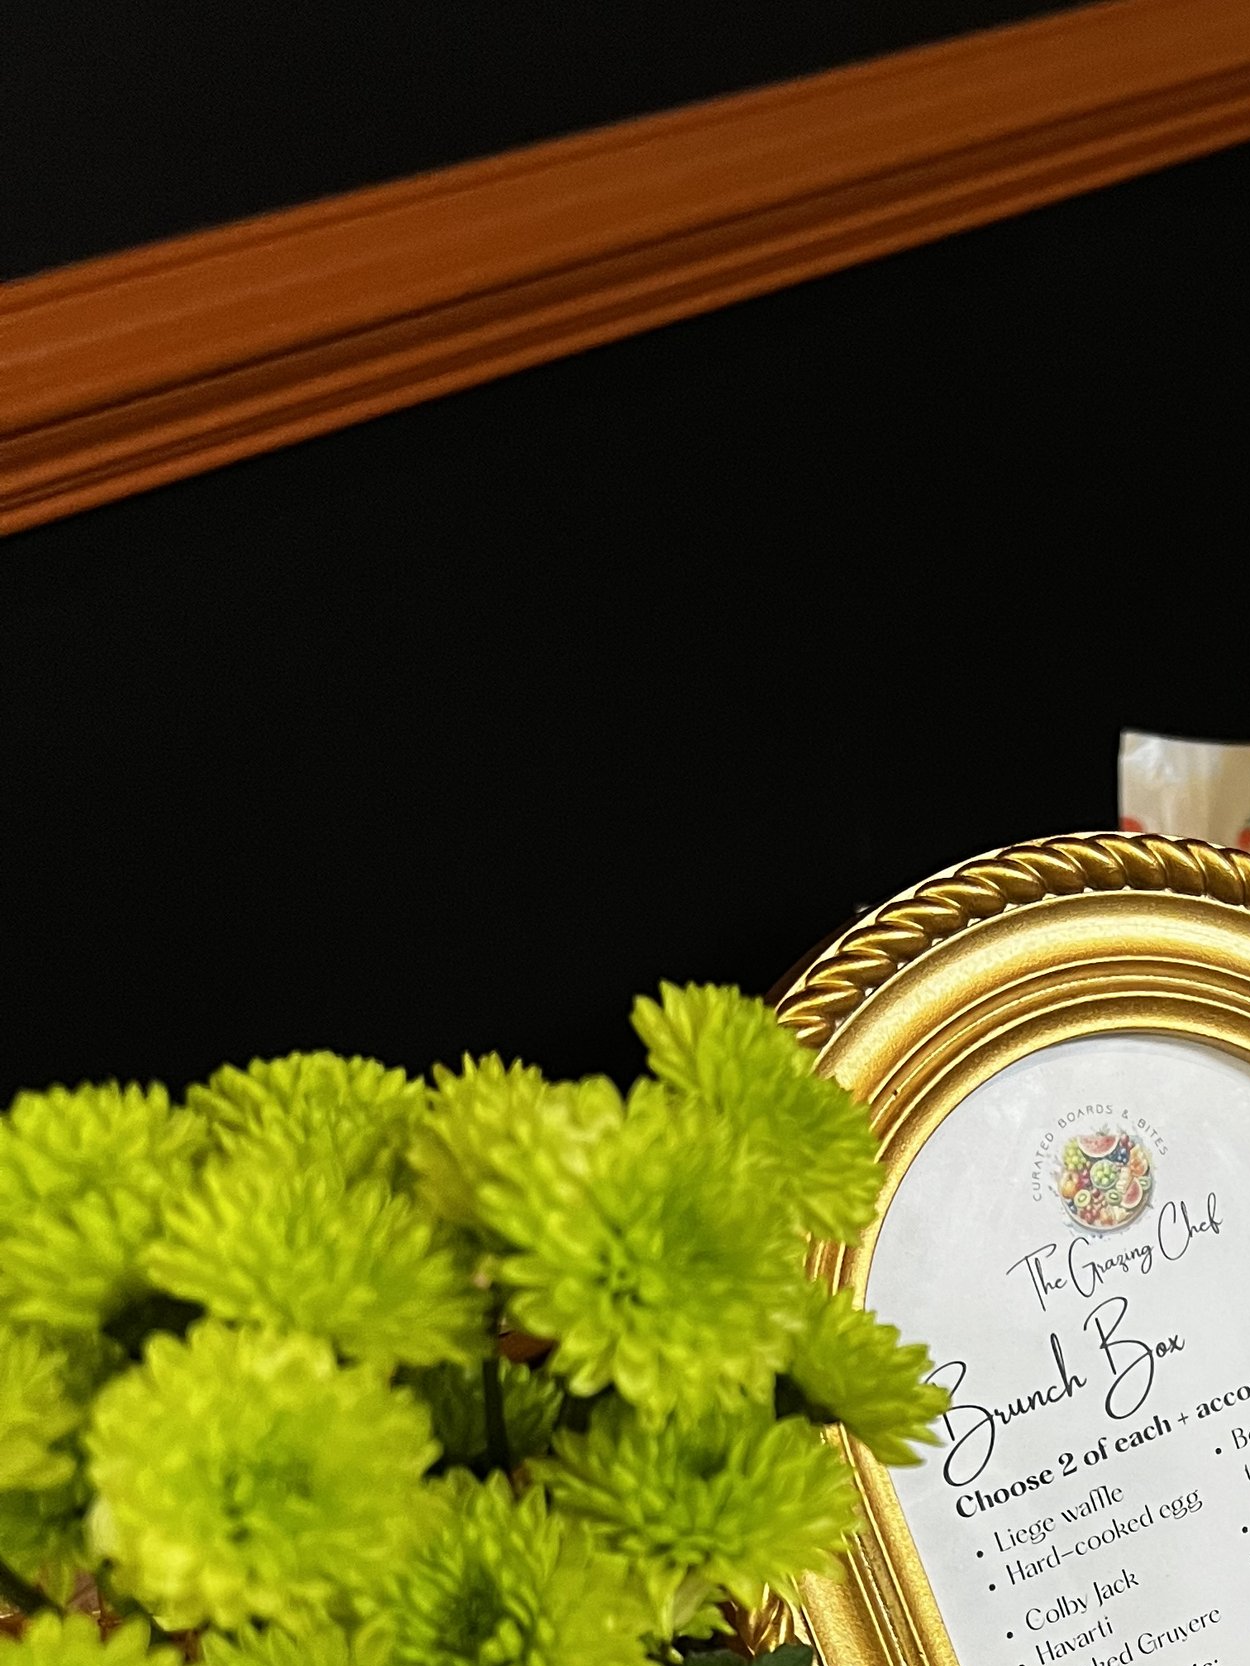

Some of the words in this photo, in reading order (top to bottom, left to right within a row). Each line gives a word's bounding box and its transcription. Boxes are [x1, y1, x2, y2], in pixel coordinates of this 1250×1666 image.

[1031, 1132, 1054, 1202] CURATED
[1057, 1104, 1113, 1129] BOARDS
[1121, 1108, 1129, 1120] &
[1136, 1118, 1168, 1156] BITES
[1006, 1243, 1068, 1312] The
[1068, 1236, 1155, 1298] Grazing
[1158, 1192, 1224, 1261] Chef
[924, 1333, 1088, 1487] Brunch
[1083, 1296, 1186, 1420] Box
[955, 1468, 1055, 1519] Choose
[1058, 1452, 1078, 1477] 2
[1083, 1437, 1109, 1467] of
[1114, 1415, 1172, 1453] each
[1177, 1412, 1190, 1426] +
[994, 1516, 1056, 1553] Liege
[1061, 1485, 1125, 1523] waffle
[1159, 1488, 1203, 1520] egg
[1025, 1593, 1089, 1631] Colby
[1093, 1569, 1140, 1607] Jack
[1137, 1608, 1222, 1655] Gruyere
[1036, 1616, 1114, 1666] Havarti
